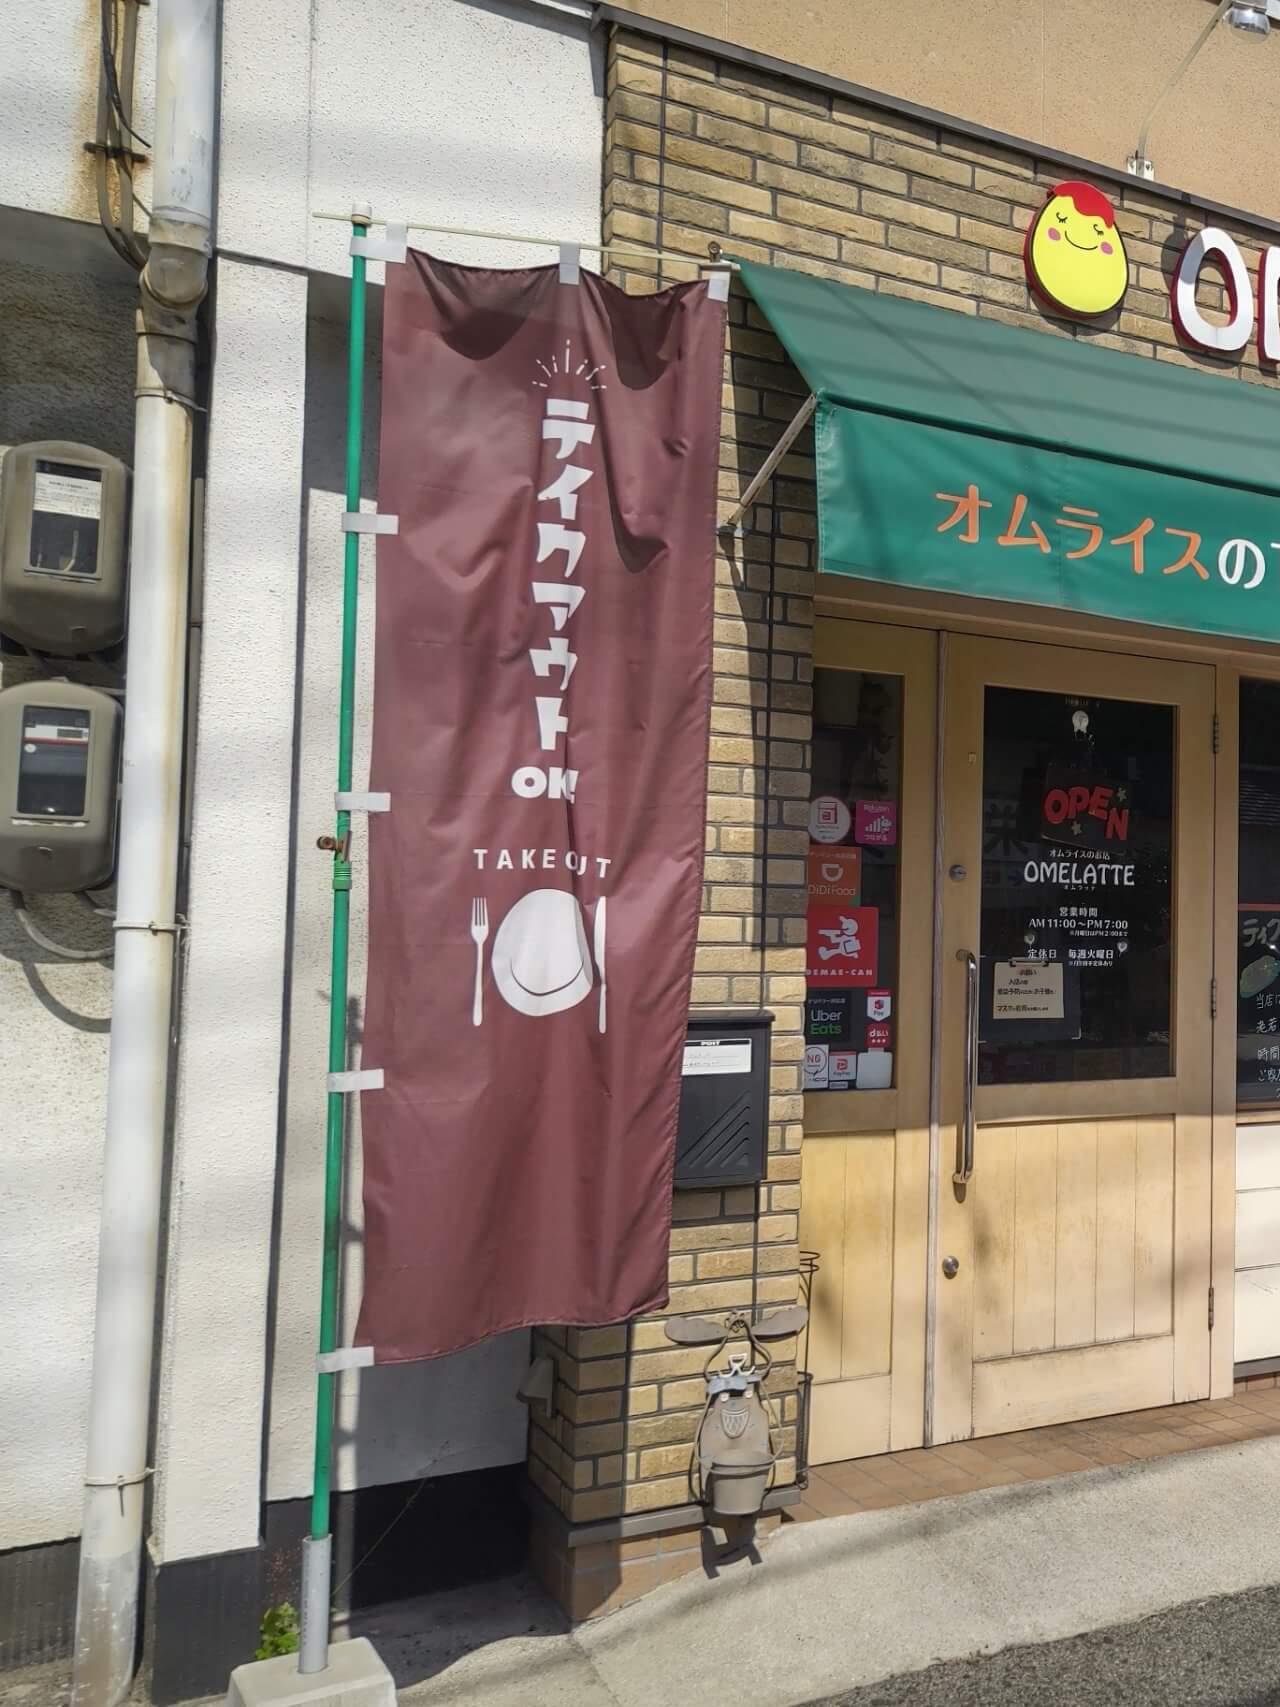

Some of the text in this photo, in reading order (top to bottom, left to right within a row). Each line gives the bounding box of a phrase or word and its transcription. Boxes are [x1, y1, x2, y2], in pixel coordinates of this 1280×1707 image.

[529, 398, 596, 750] テイクアウト
[1043, 786, 1130, 841] OPEN
[1049, 848, 1111, 861] オムライスのお店
[473, 848, 612, 879] TAKEOUT
[1023, 860, 1136, 886] OMELATTE
[1058, 906, 1098, 917] 営業時間
[1027, 948, 1114, 960] 定休日 毎週火曜日
[805, 968, 873, 976] DEMAE-CAN
[810, 1009, 842, 1022] Uber
[810, 1023, 842, 1035] Eats
